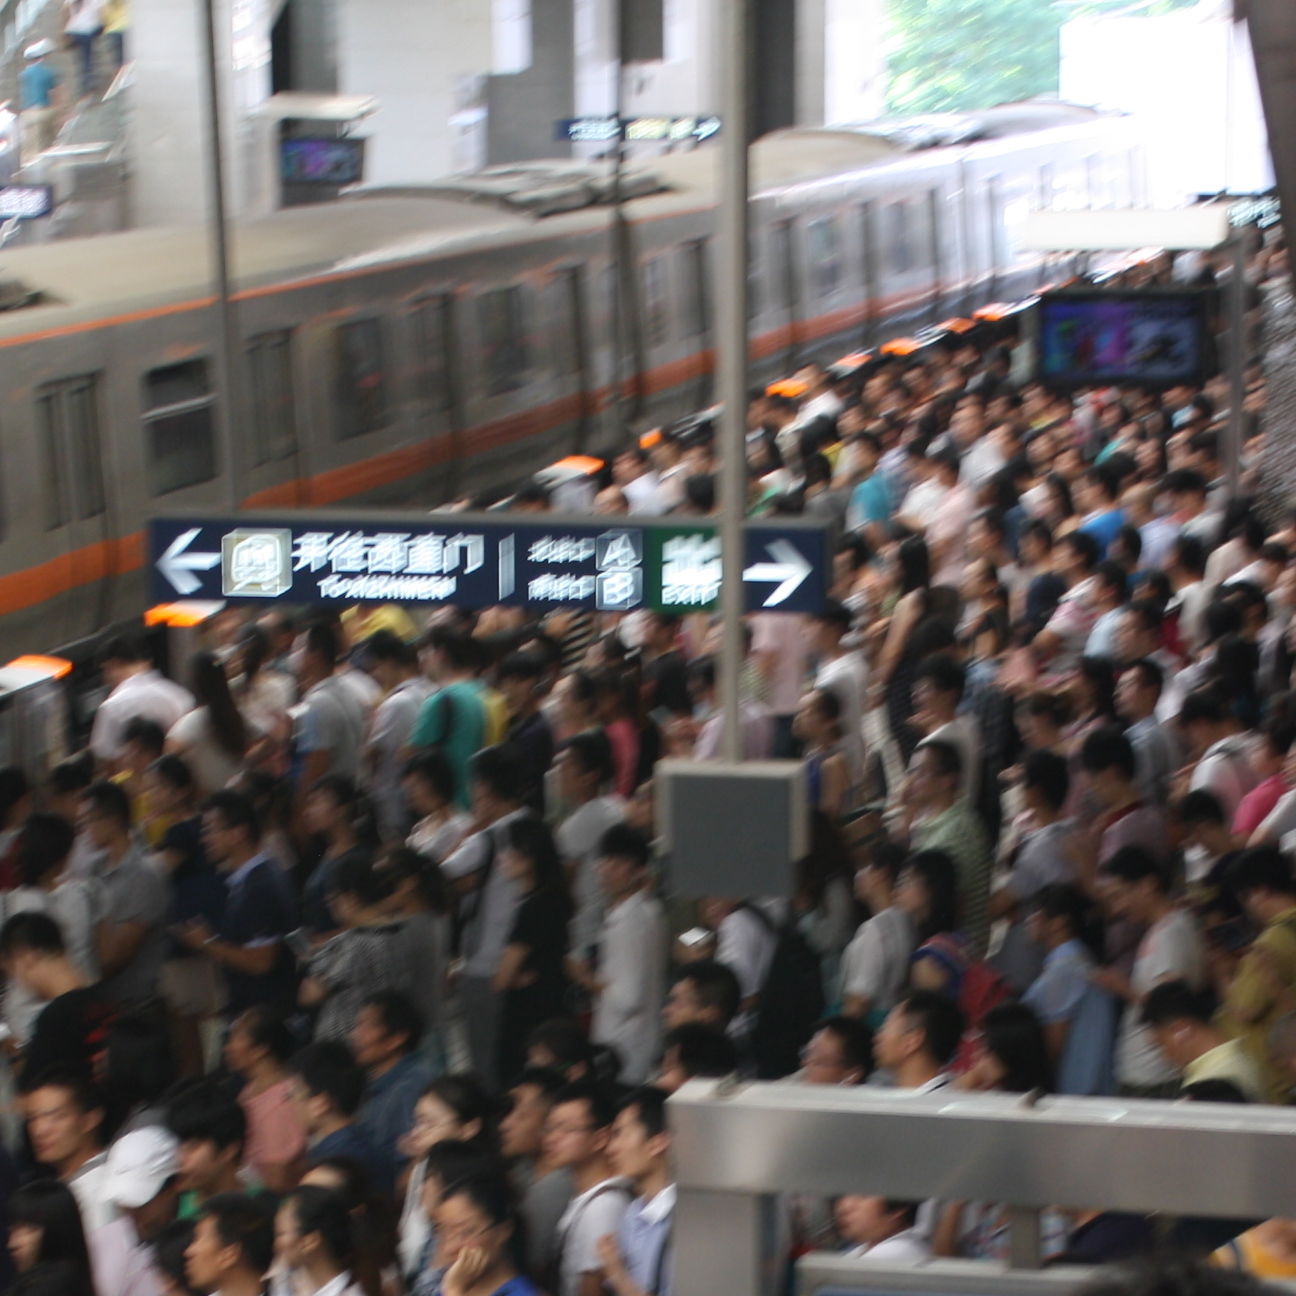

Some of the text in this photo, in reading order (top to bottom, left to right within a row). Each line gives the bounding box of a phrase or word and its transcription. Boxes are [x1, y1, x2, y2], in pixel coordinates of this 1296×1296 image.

[291, 530, 484, 574] 开往西直门
[601, 533, 637, 566] A
[602, 570, 635, 605] B
